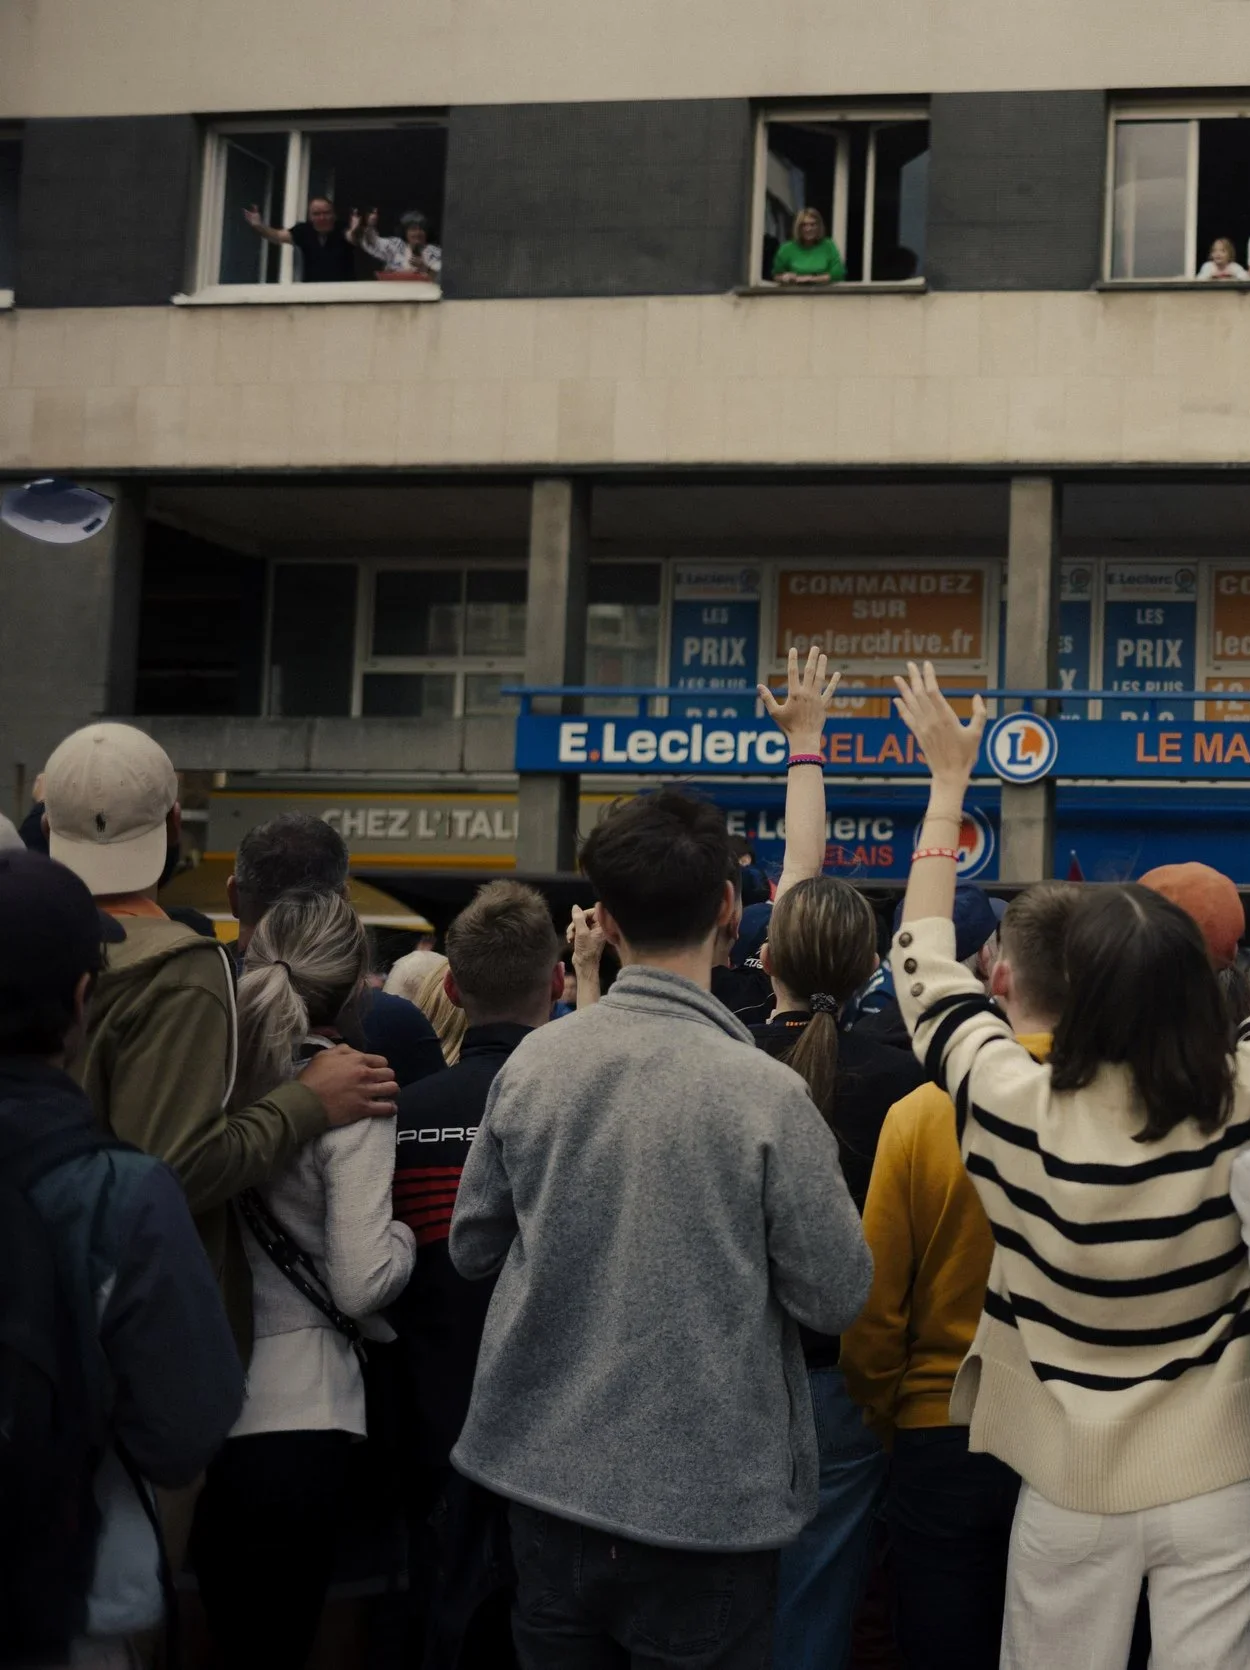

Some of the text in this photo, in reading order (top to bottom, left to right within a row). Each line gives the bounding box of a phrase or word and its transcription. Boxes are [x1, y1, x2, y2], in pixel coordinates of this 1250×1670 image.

[788, 575, 973, 595] COMMANDEZ
[702, 607, 730, 625] LES
[852, 599, 907, 619] SUR
[1136, 608, 1165, 625] LES
[682, 636, 748, 667] PRIX
[783, 628, 974, 655] leclercdrive.fr
[1116, 638, 1184, 669] PRIX
[558, 722, 786, 764] E.Leclerc
[1136, 732, 1183, 763] LE
[320, 808, 409, 838] CHEZ
[824, 844, 894, 867] ELAIS
